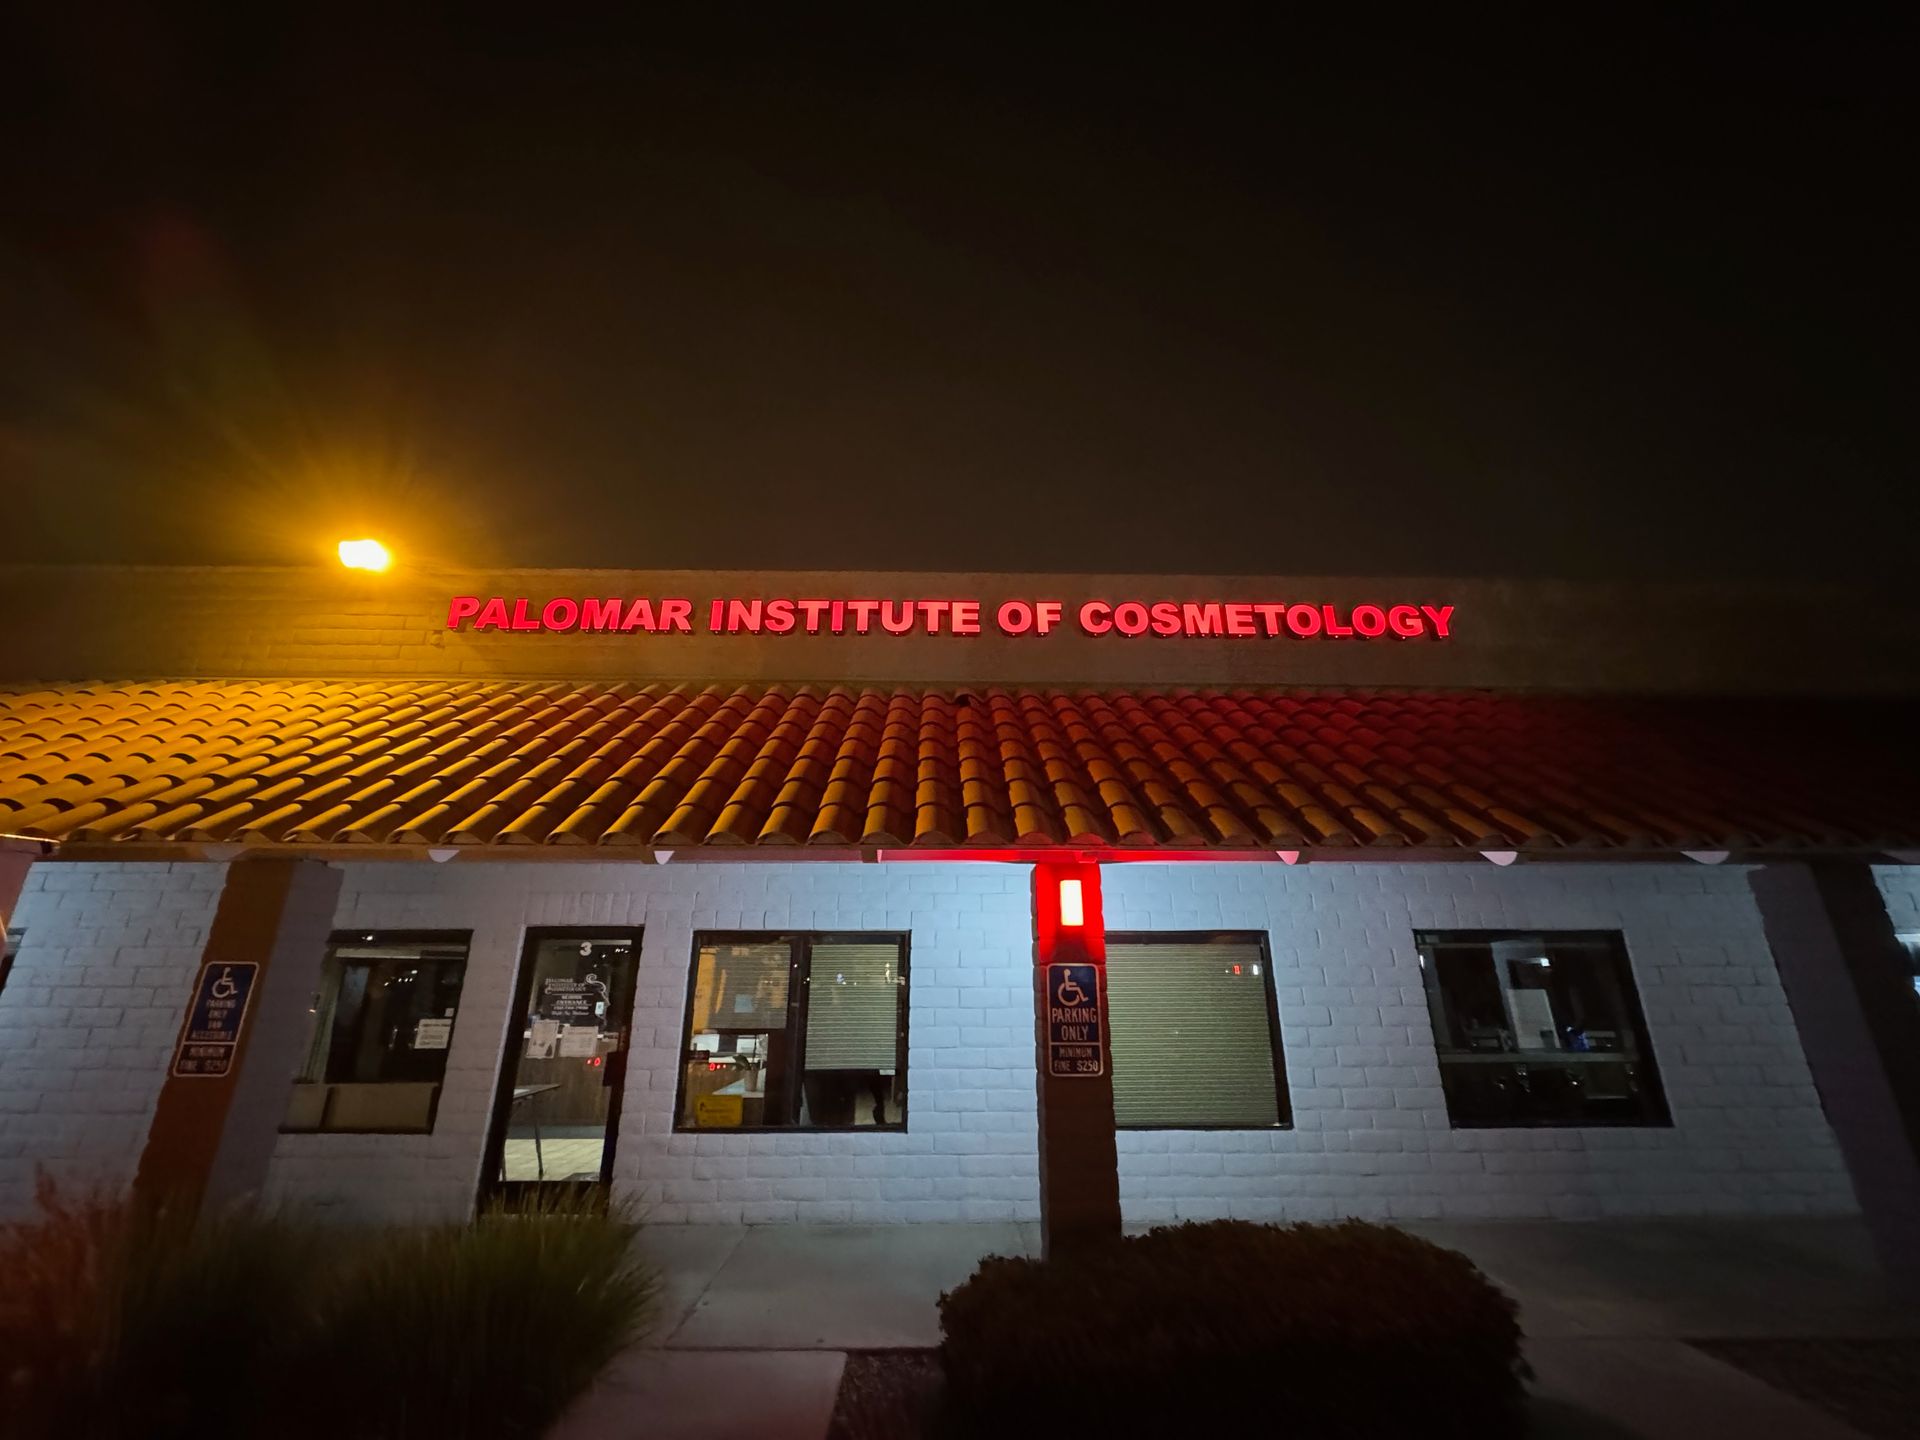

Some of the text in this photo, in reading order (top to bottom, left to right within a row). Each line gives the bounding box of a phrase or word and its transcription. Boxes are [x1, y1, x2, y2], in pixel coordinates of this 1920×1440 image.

[447, 597, 1456, 639] PALOMAR INSTITUTE OF COSMETOLOGY
[580, 941, 592, 956] 3
[1051, 1007, 1098, 1024] PARKING
[1061, 1025, 1090, 1041] ONLY
[1059, 1047, 1093, 1058] MINIMUM
[1054, 1060, 1099, 1072] FINE $250
